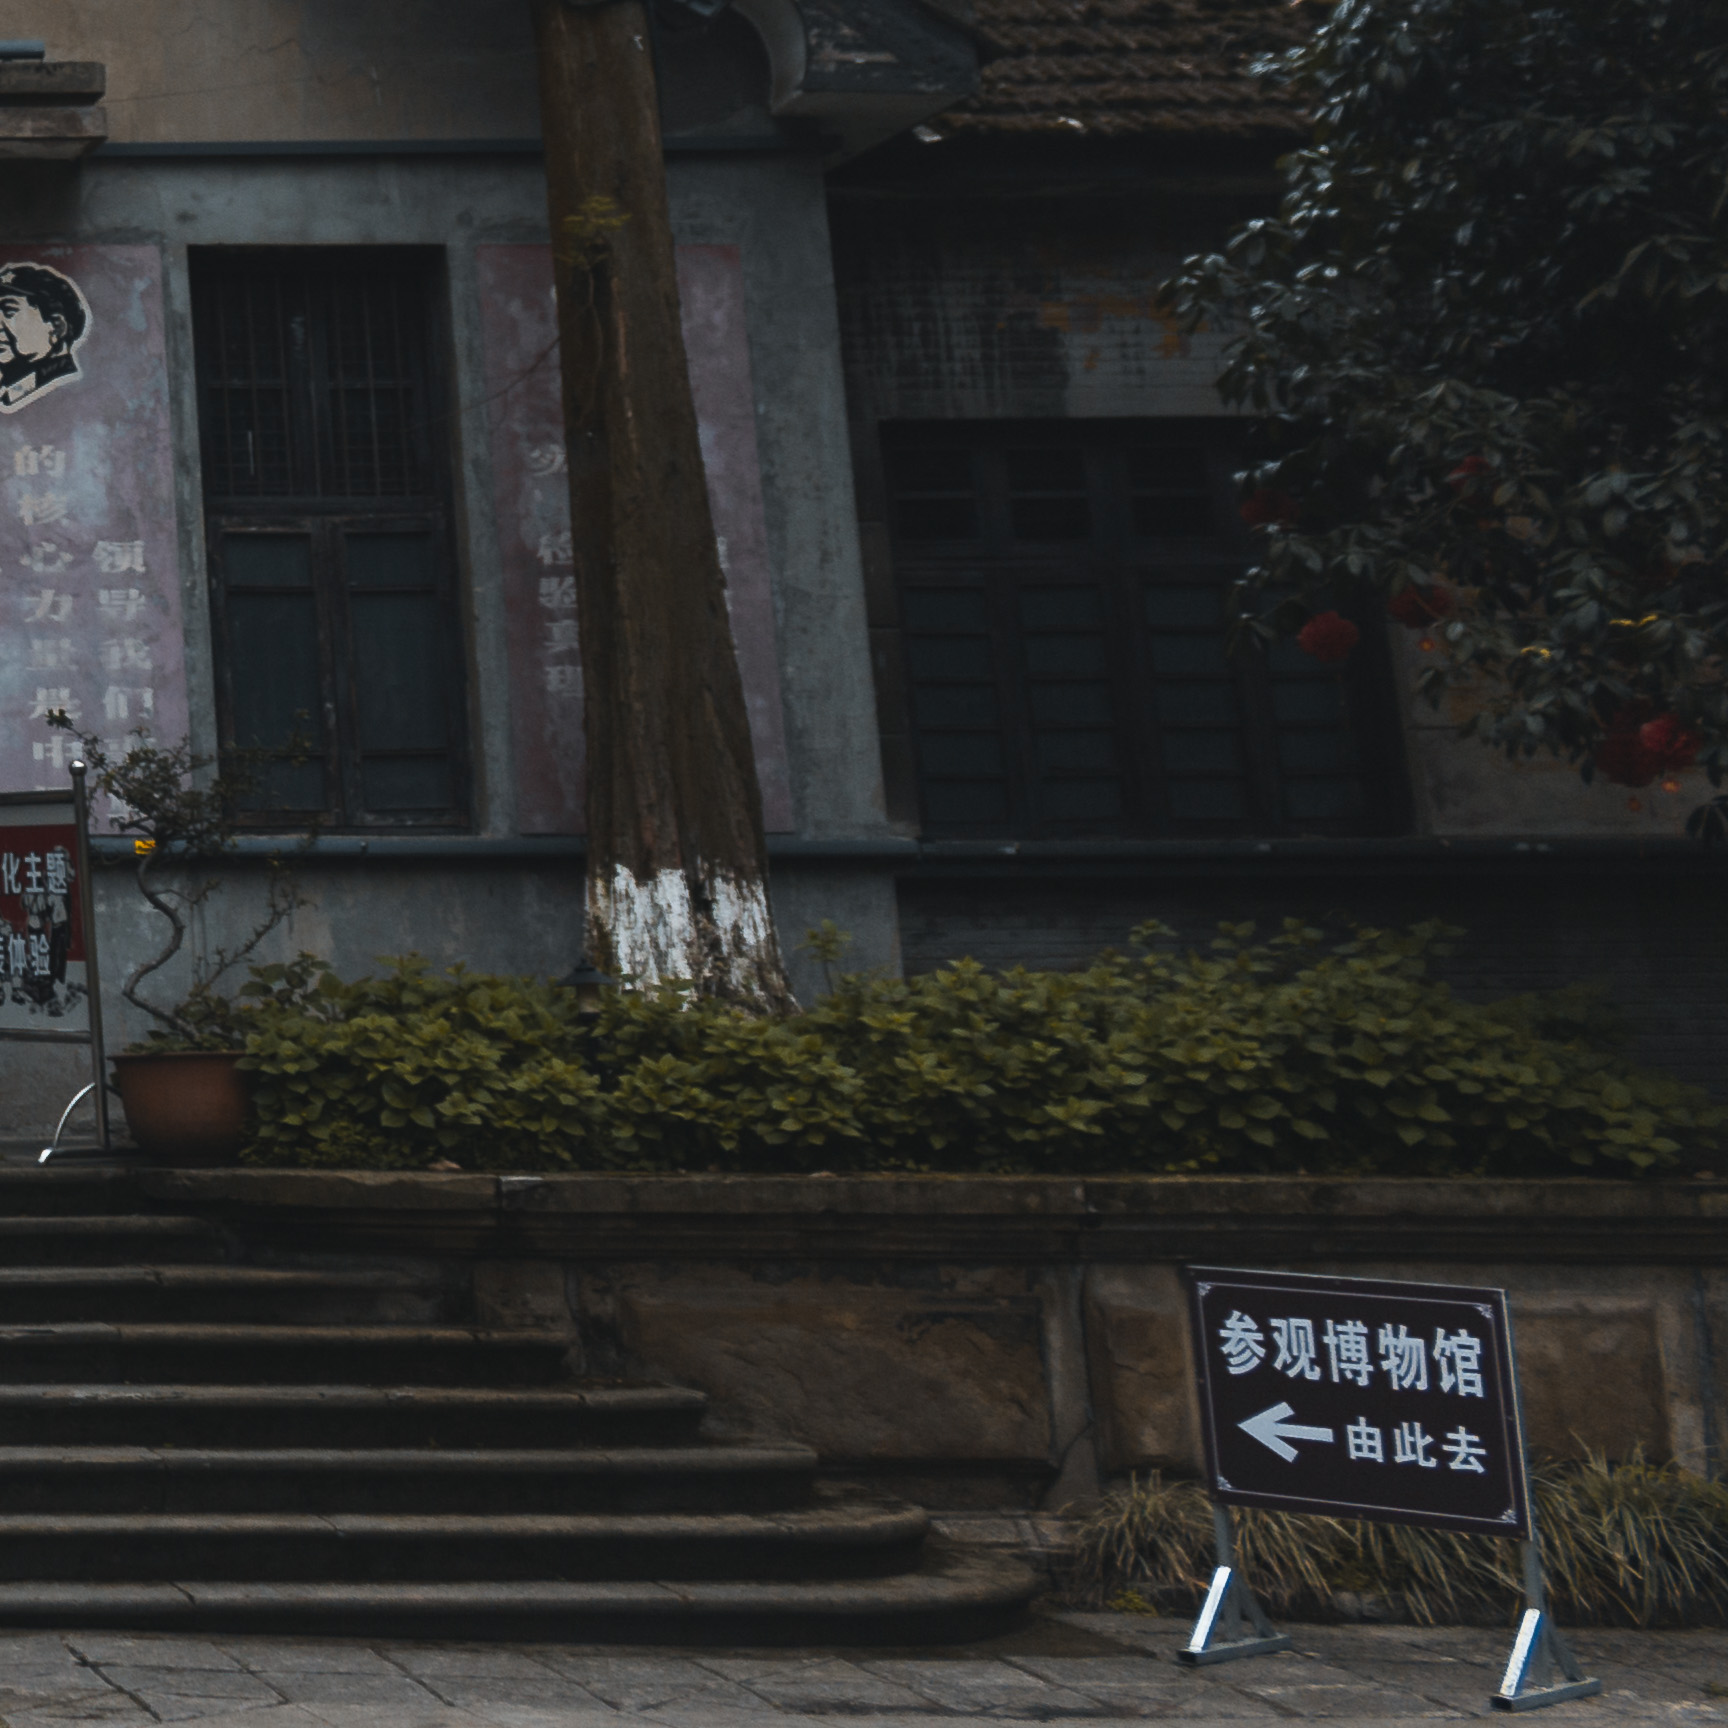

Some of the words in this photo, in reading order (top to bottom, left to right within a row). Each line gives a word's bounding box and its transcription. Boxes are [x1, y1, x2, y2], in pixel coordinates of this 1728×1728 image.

[14, 445, 83, 792] 的核心力量是中
[1218, 1309, 1485, 1398] 参观博物馆
[1346, 1415, 1487, 1474] 由此去
